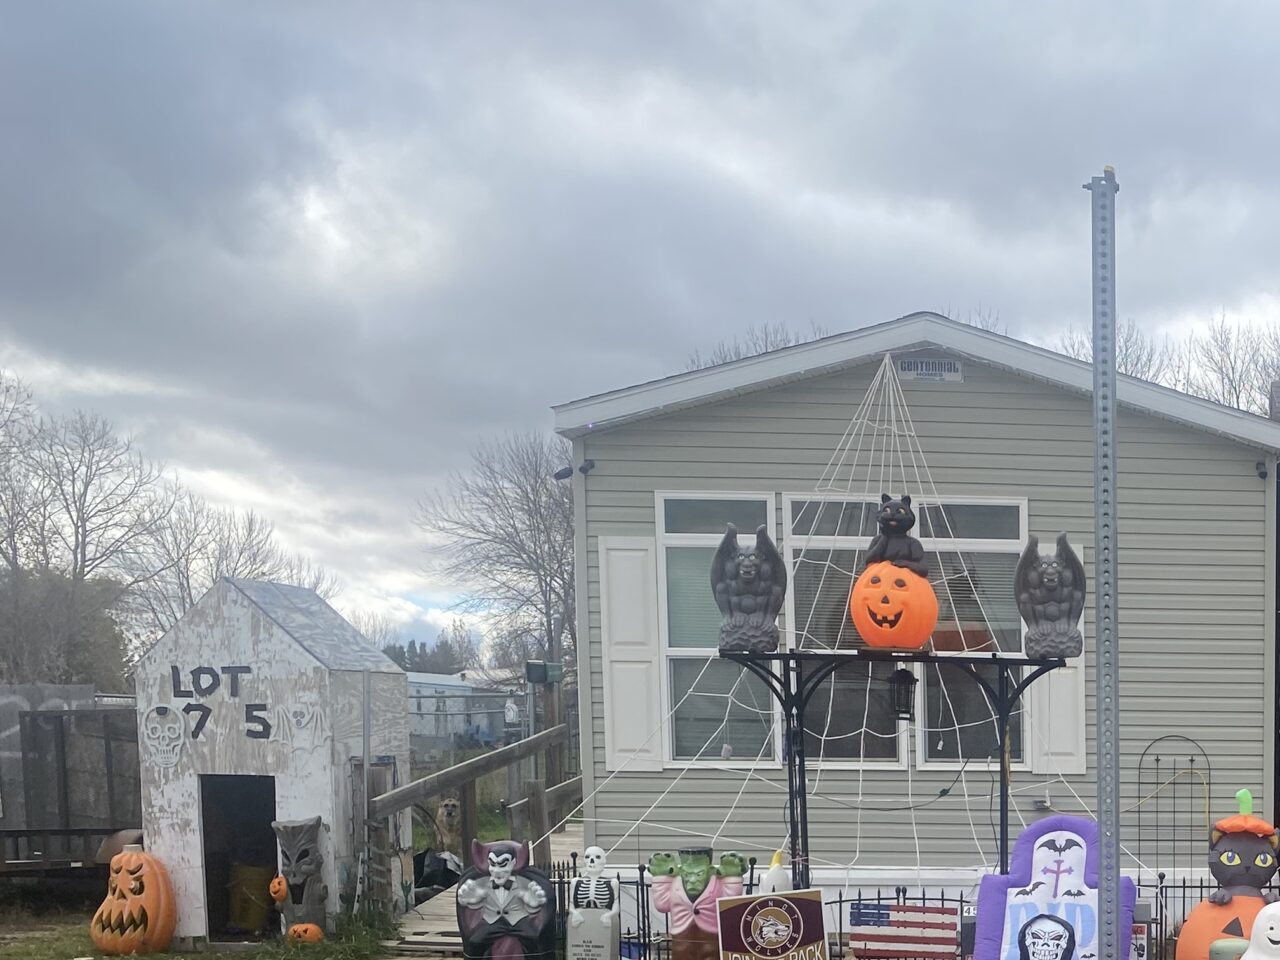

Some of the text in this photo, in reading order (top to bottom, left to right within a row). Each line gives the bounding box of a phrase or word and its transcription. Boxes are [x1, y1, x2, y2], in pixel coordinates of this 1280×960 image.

[170, 665, 252, 699] LOT
[182, 702, 272, 740] 7 5
[745, 899, 798, 921] MINOT
[746, 932, 799, 956] WOLVES
